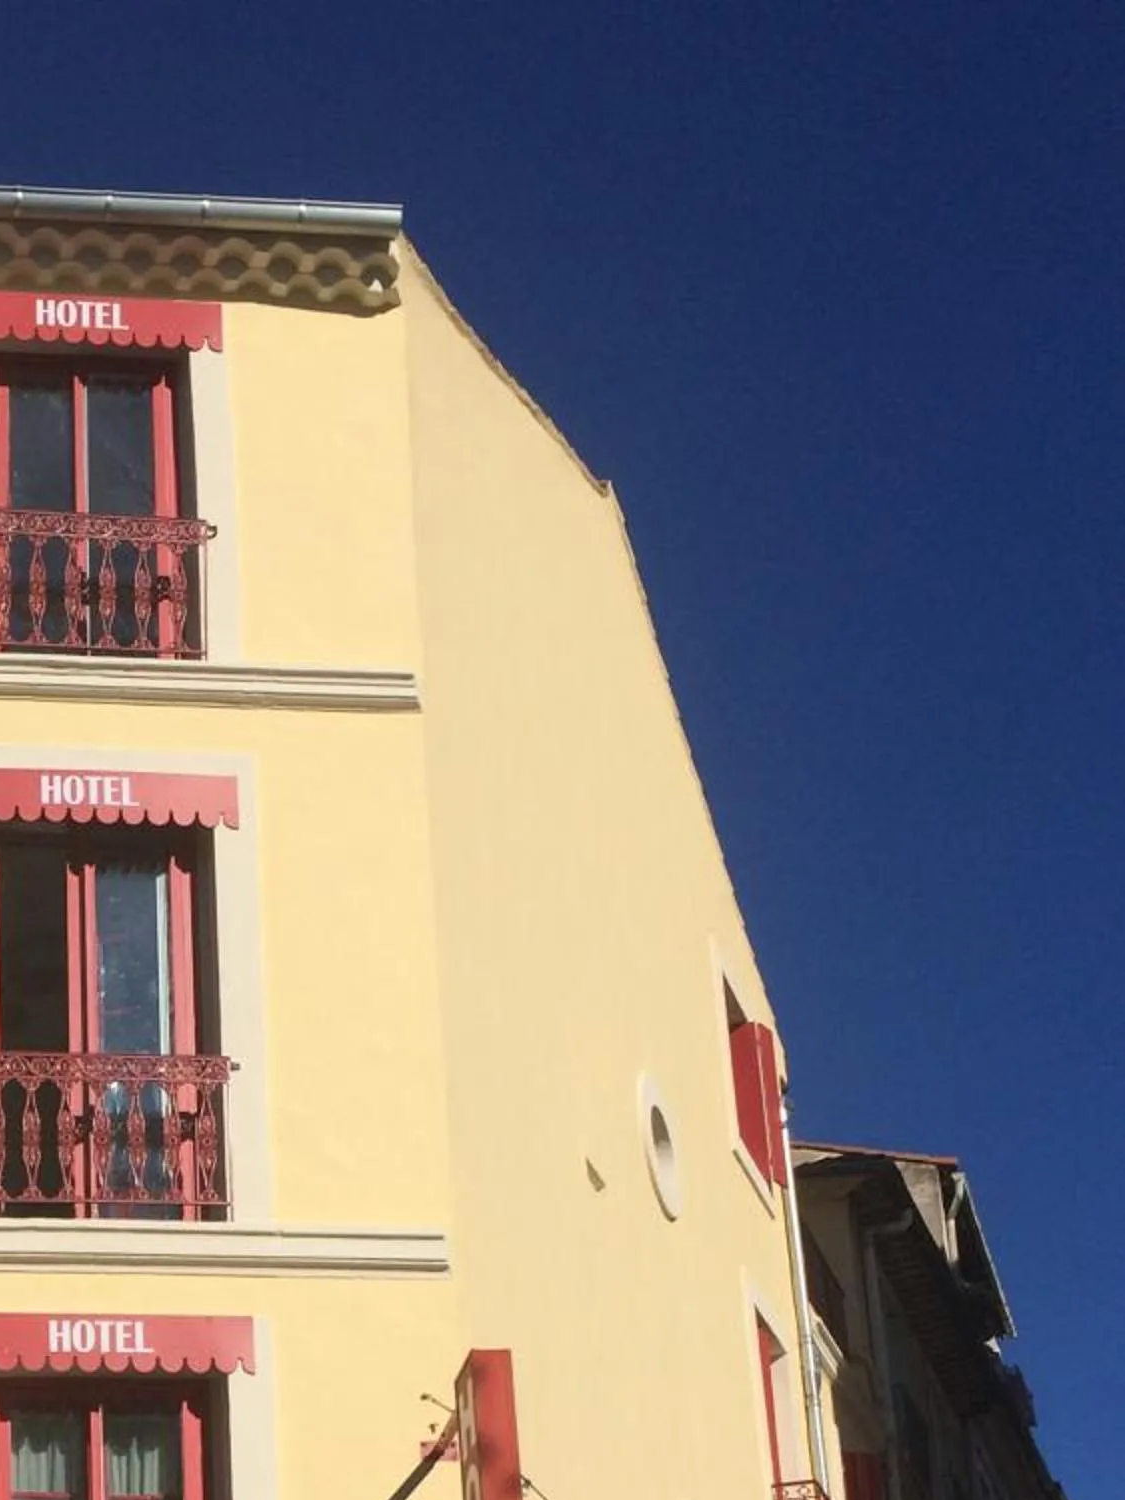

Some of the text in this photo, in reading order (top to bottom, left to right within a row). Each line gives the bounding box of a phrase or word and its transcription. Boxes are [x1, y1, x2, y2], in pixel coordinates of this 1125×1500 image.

[35, 299, 130, 331] HOTEL
[40, 774, 140, 807] HOTEL
[48, 1319, 155, 1353] HOTEL
